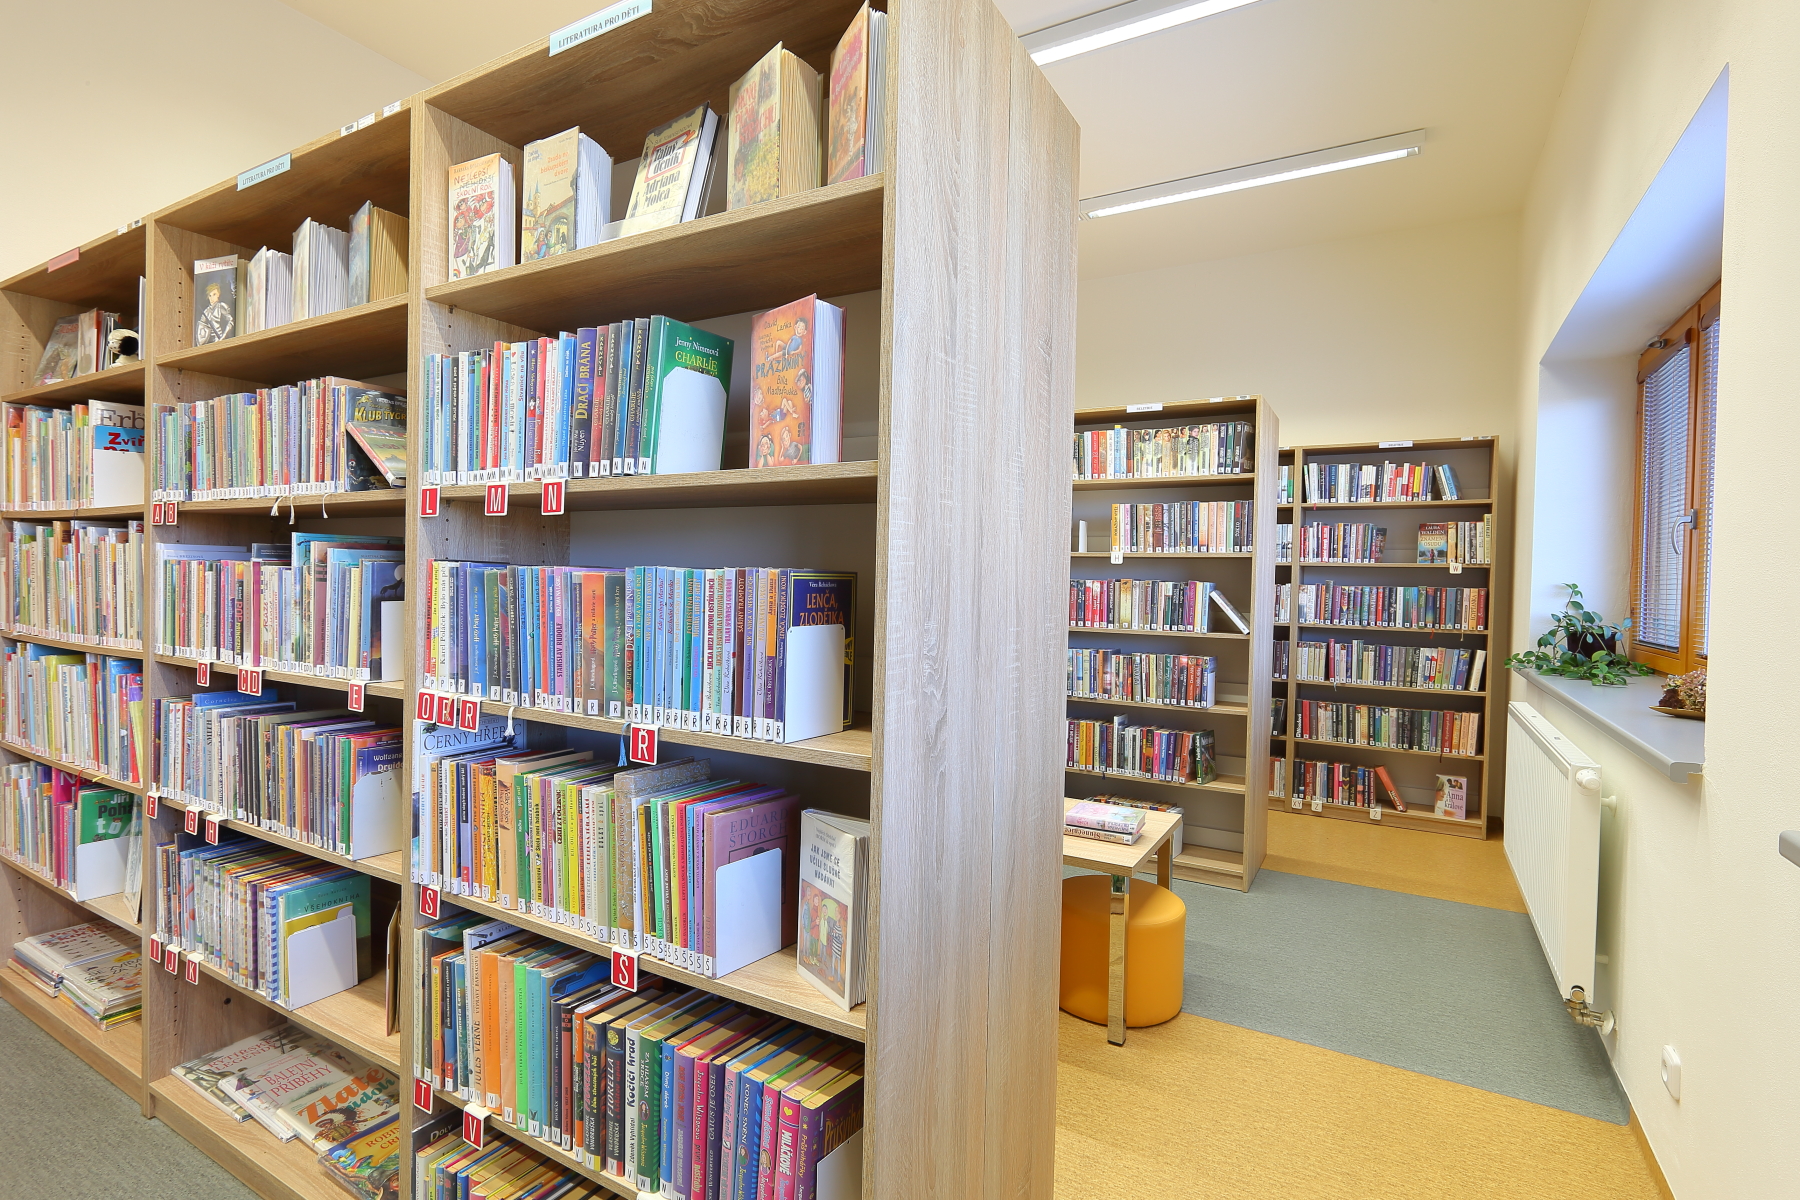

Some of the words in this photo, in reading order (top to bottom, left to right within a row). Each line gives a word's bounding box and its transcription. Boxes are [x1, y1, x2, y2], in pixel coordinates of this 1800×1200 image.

[558, 22, 603, 48] LITERATURA
[604, 14, 620, 27] PRO
[621, 5, 640, 21] DĚTI
[654, 152, 680, 174] deník
[242, 170, 266, 185] LITERATURA
[266, 167, 274, 175] PRO
[675, 336, 691, 350] Jenny
[580, 341, 591, 378] BRÁNA
[675, 350, 718, 372] CHARLIE
[574, 383, 589, 419] DRAČÍ
[354, 406, 382, 422] KLUB
[425, 490, 433, 513] L
[490, 487, 502, 512] M
[548, 484, 558, 511] N
[154, 504, 160, 522] A
[169, 503, 174, 522] B
[440, 593, 448, 609] Bylo
[806, 590, 838, 610] LENČA,
[800, 610, 844, 626] ZLODĚJKA
[200, 664, 206, 683] C
[241, 669, 247, 690] C
[252, 671, 258, 692] D
[353, 685, 359, 708] E
[422, 695, 430, 719] O
[466, 703, 473, 727] R
[639, 728, 649, 759] Ř
[111, 793, 129, 804] Jiří
[150, 798, 155, 815] F
[1446, 791, 1463, 801] Anna
[188, 812, 194, 830] G
[208, 821, 215, 842] H
[729, 807, 789, 834] EDUARD
[728, 822, 789, 848] ŠTORCH
[304, 893, 360, 912] VŠEHOKNIHA
[425, 890, 434, 914] S
[169, 952, 174, 970] J
[189, 959, 195, 980] K
[618, 954, 629, 984] Š
[627, 1036, 635, 1067] hrad
[474, 1056, 482, 1086] JULES
[298, 1066, 386, 1125] Zlaté
[419, 1084, 428, 1110] T
[627, 1070, 635, 1108] Kočičí
[742, 1083, 750, 1115] KONEC
[468, 1115, 478, 1142] V
[695, 1105, 704, 1140] Wilsonová
[779, 1129, 793, 1176] MILÁČKOVÉ
